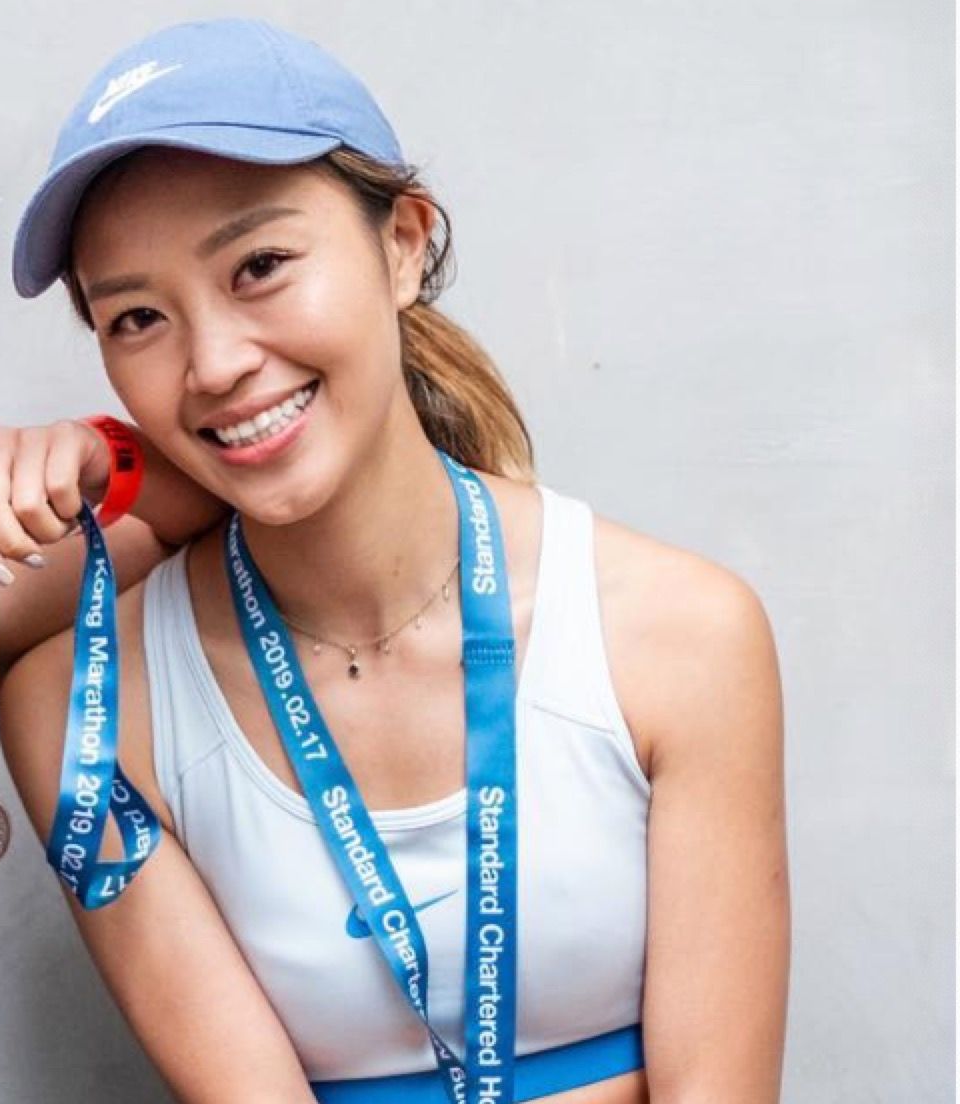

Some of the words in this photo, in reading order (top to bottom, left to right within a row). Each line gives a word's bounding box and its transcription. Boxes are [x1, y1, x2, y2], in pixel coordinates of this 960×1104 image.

[85, 557, 109, 629] Kong
[458, 478, 497, 595] Standard
[80, 636, 109, 765] Marathon
[259, 631, 329, 761] 2019.02.17
[322, 785, 394, 906] Standard
[479, 787, 505, 915] Standard
[478, 923, 505, 1067] Chartered
